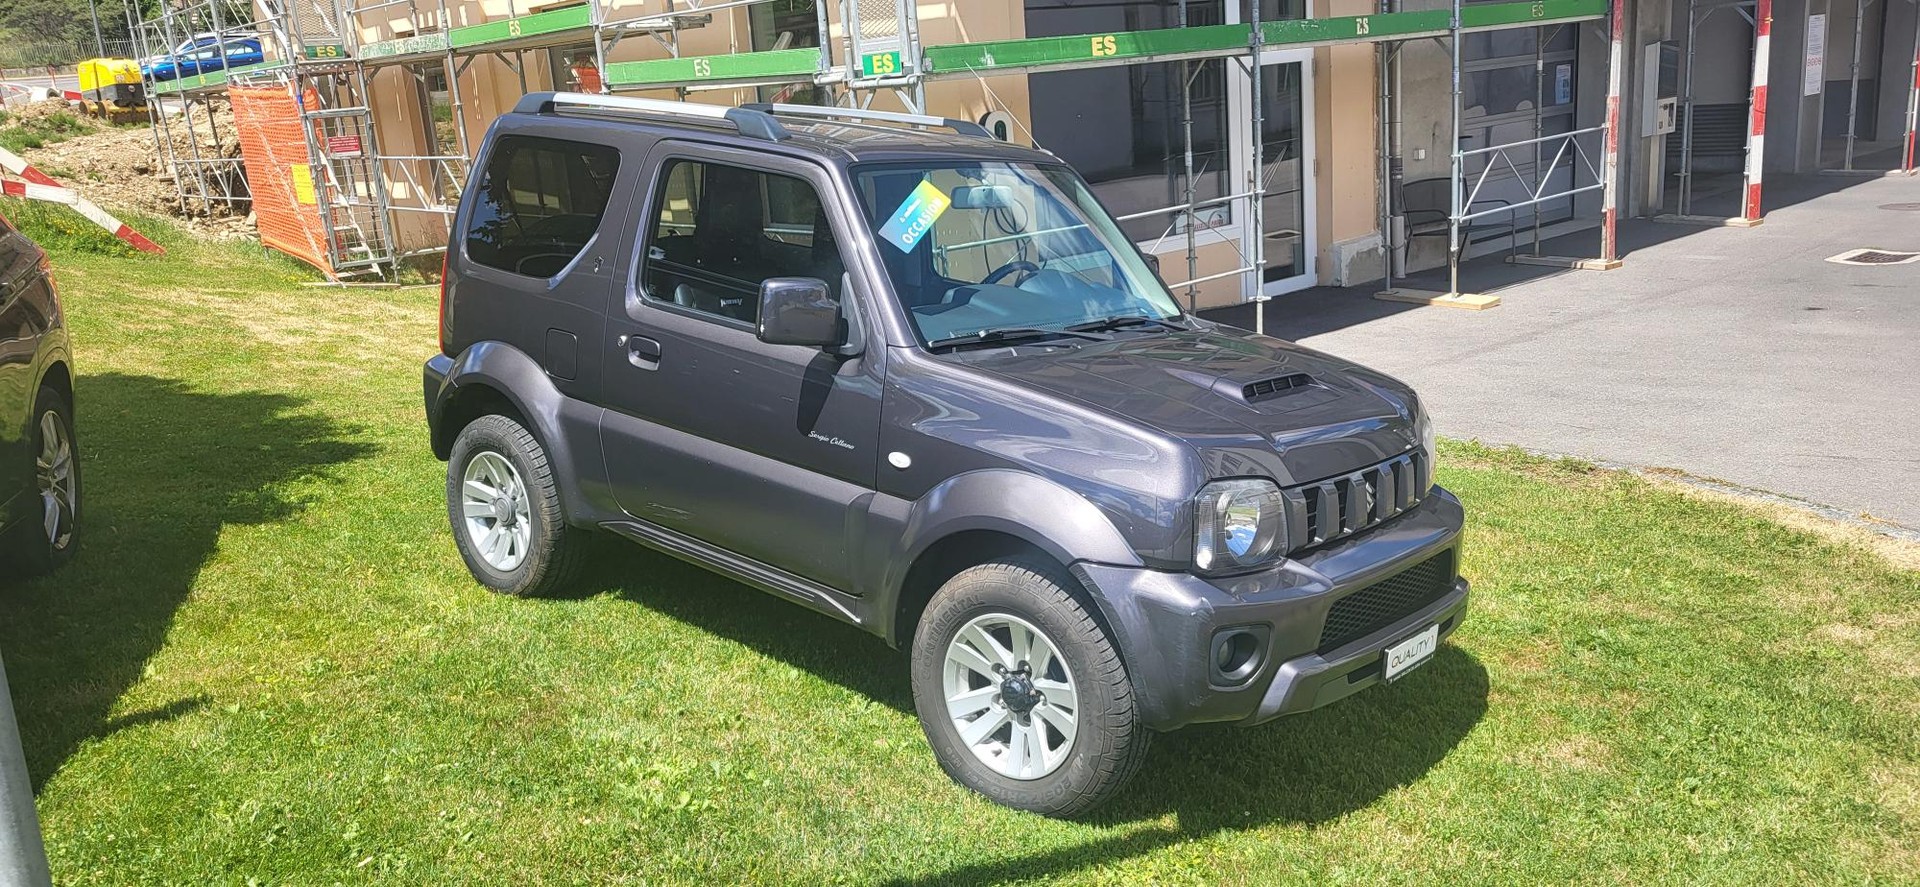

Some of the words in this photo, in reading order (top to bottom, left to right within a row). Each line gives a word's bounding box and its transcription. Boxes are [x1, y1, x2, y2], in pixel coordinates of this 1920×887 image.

[1532, 4, 1544, 17] ES
[509, 20, 521, 36] ES
[316, 45, 337, 57] ES
[1091, 35, 1117, 56] ES
[693, 59, 711, 77] ES
[872, 53, 895, 74] ES
[902, 197, 943, 244] OCCASION
[1391, 636, 1431, 669] QUALITY
